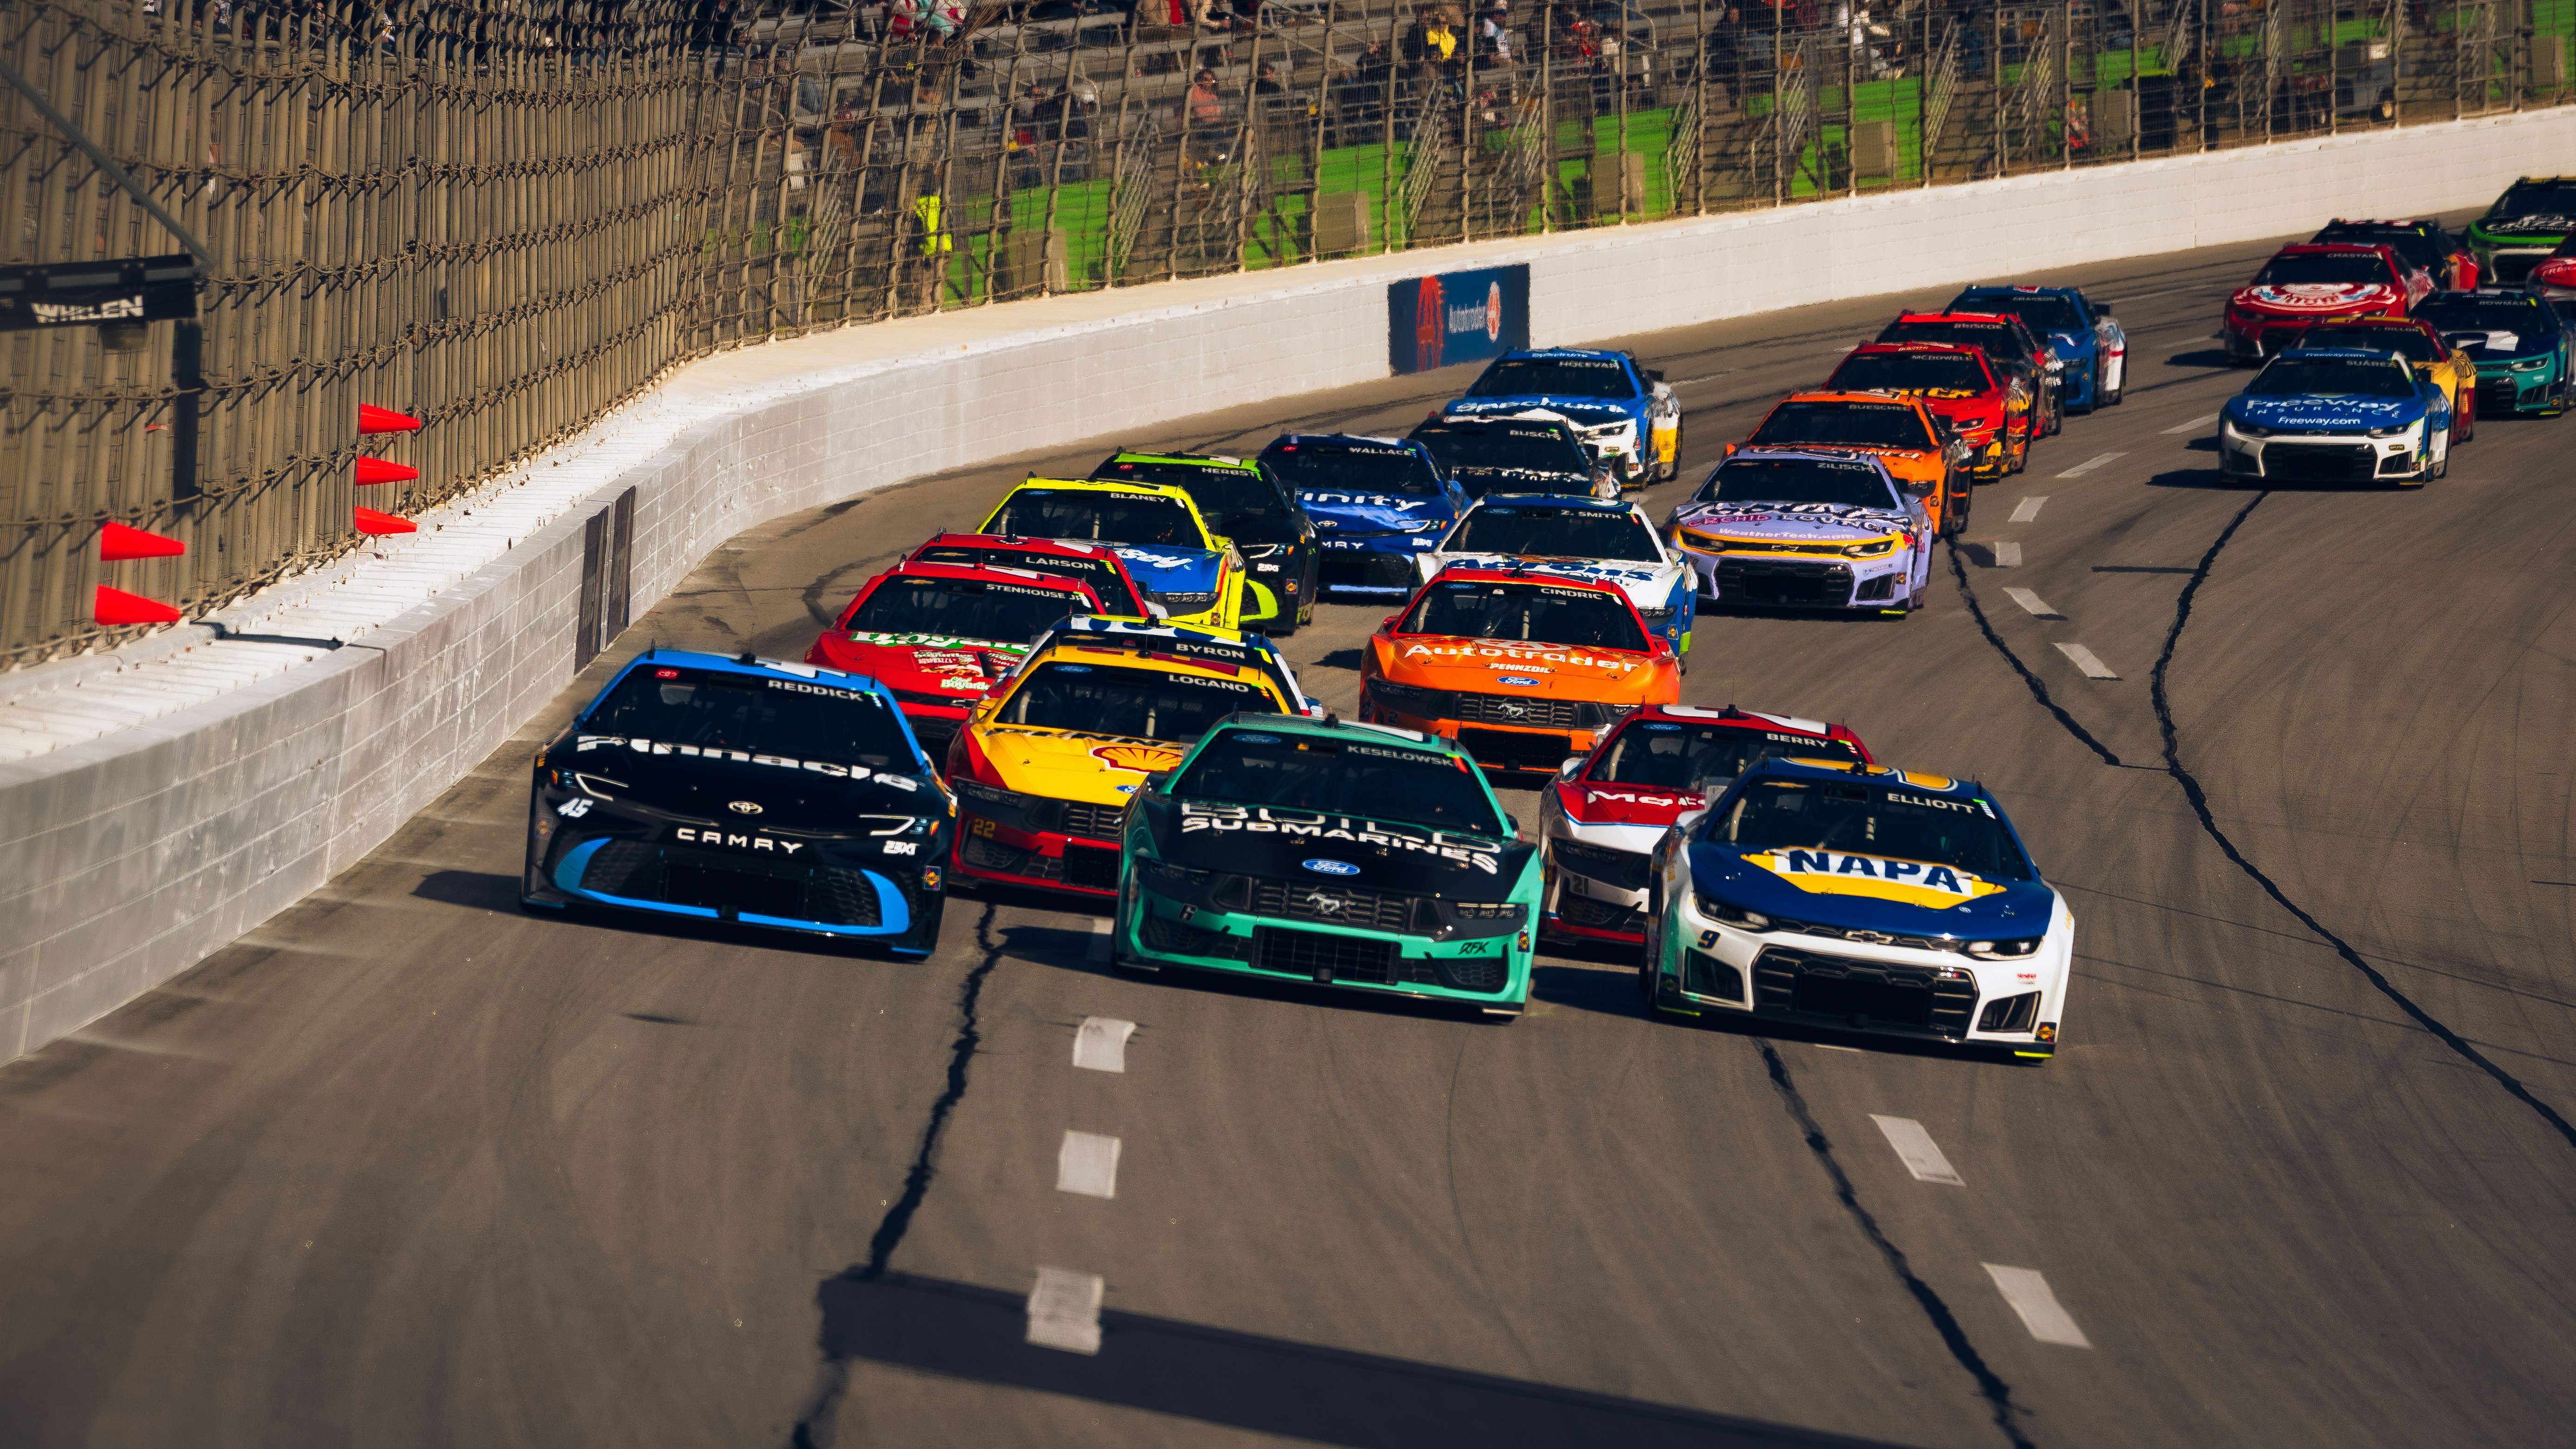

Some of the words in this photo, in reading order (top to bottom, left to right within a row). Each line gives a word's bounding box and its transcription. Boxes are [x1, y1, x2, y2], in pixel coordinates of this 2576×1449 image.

[31, 295, 144, 323] WHELEN
[2247, 399, 2402, 411] Freeway
[2278, 416, 2361, 426] Freeway.com
[1349, 447, 1413, 456] WALLACE
[1202, 467, 1255, 477] HERBST
[1110, 492, 1166, 503] BLANEY
[1026, 556, 1096, 571] LARSON
[986, 583, 1066, 600] STENHOUSE
[1541, 588, 1602, 600] CINDRIC
[1176, 643, 1246, 659] BYRON
[1404, 645, 1640, 673] Autotrader
[1489, 662, 1551, 673] PENNZOIL
[768, 679, 864, 702] REDDICK
[1169, 673, 1249, 693] LOGANO
[1506, 677, 1532, 686] Ford
[1767, 732, 1828, 748] BERRY
[1347, 744, 1454, 766] KESELOWSK
[557, 797, 594, 818] 45
[1887, 792, 1974, 813] ELLIOTT
[973, 818, 996, 838] 22
[677, 828, 803, 854] CAMRY
[1182, 817, 1498, 874] SUBMARINES
[1314, 862, 1349, 874] Ford
[1787, 849, 1963, 893] NAPA
[1458, 932, 1490, 955] RFK
[1697, 929, 1722, 951] 9
